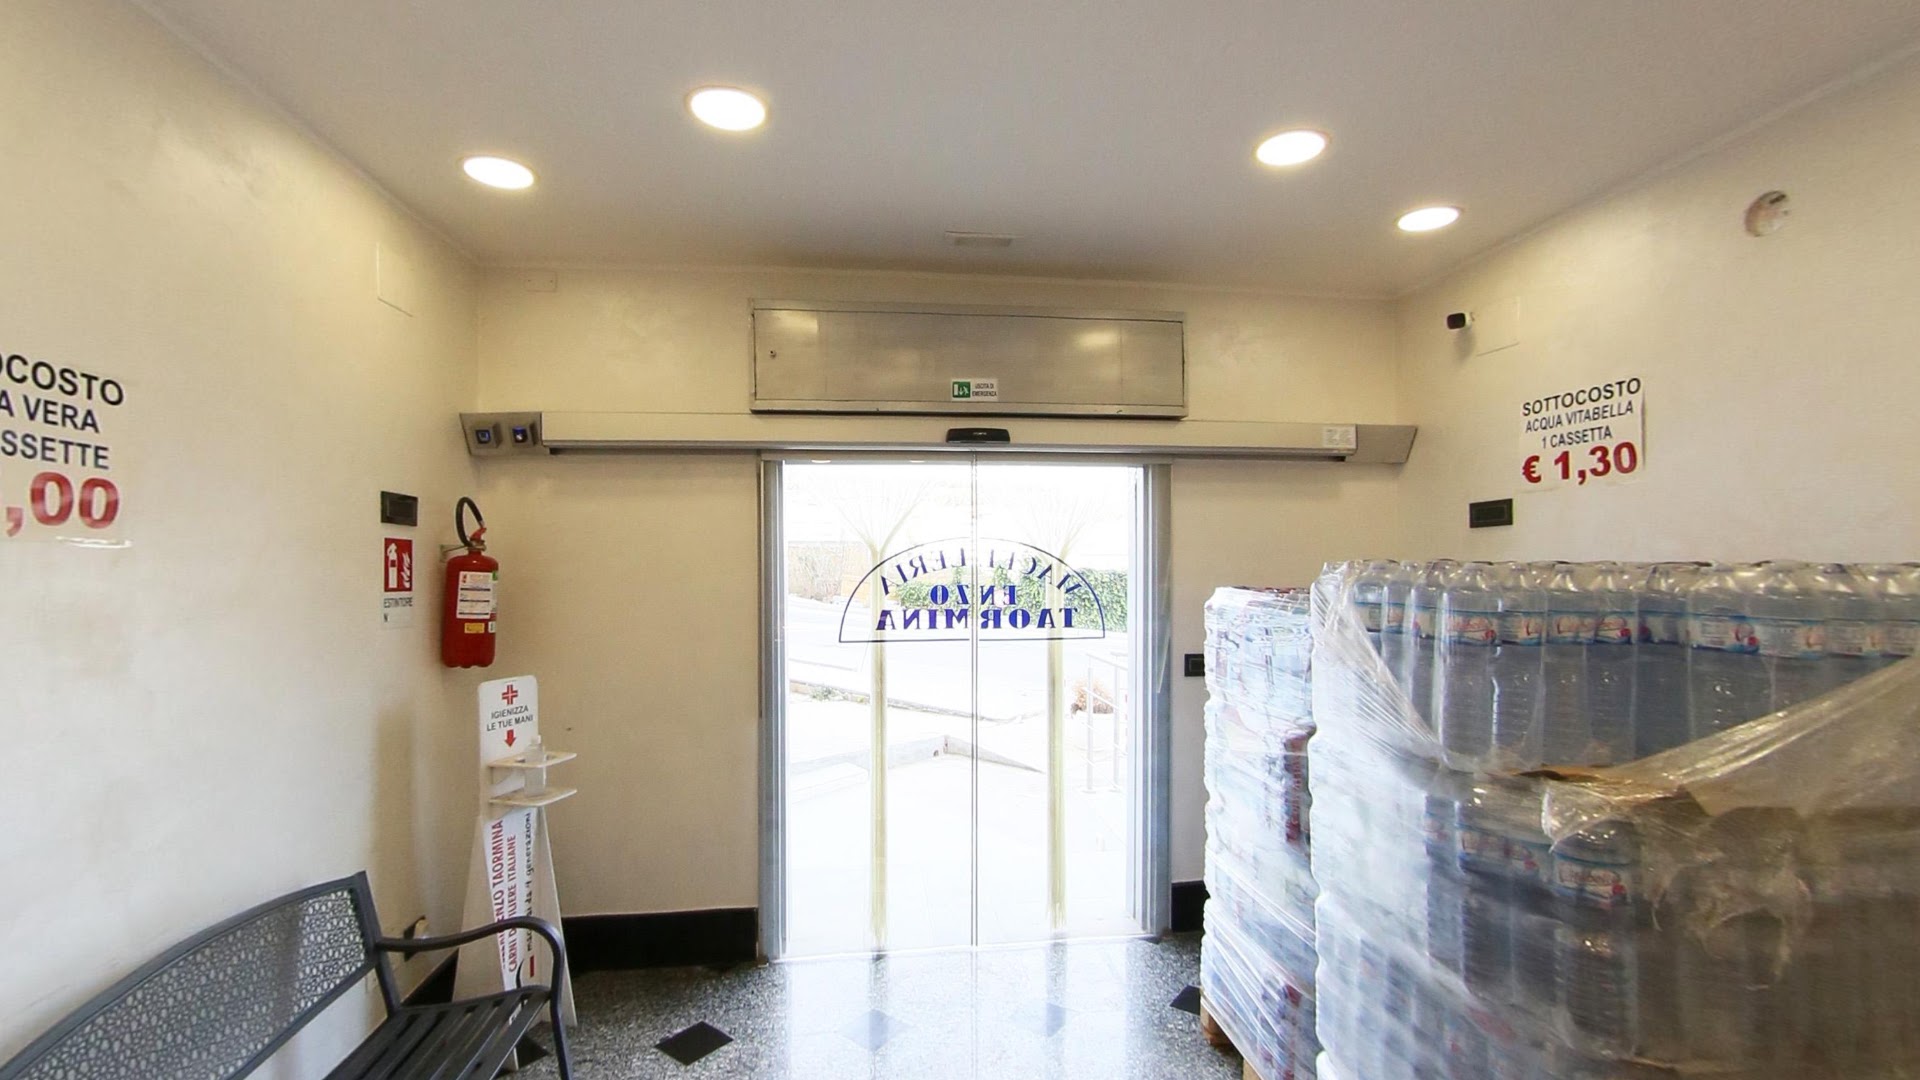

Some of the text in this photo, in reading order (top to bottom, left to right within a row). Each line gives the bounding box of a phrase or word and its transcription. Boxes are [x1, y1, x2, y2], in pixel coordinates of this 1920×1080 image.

[0, 354, 124, 406] COSTO
[1522, 377, 1641, 417] SOTTOCOSTO
[23, 394, 100, 434] VERA
[1525, 400, 1633, 434] ACQUA VITABELLA
[0, 429, 109, 470] SSETTE
[1541, 425, 1613, 449] 1 CASSETTA
[1522, 441, 1637, 485] € 1,30
[486, 714, 534, 731] LE TUE MANI
[491, 705, 529, 719] IGIENIZZA
[491, 820, 504, 888] TAORMINA
[507, 834, 516, 882] ITALIANE
[508, 884, 517, 918] ILIERE
[508, 938, 517, 972] CARNI
